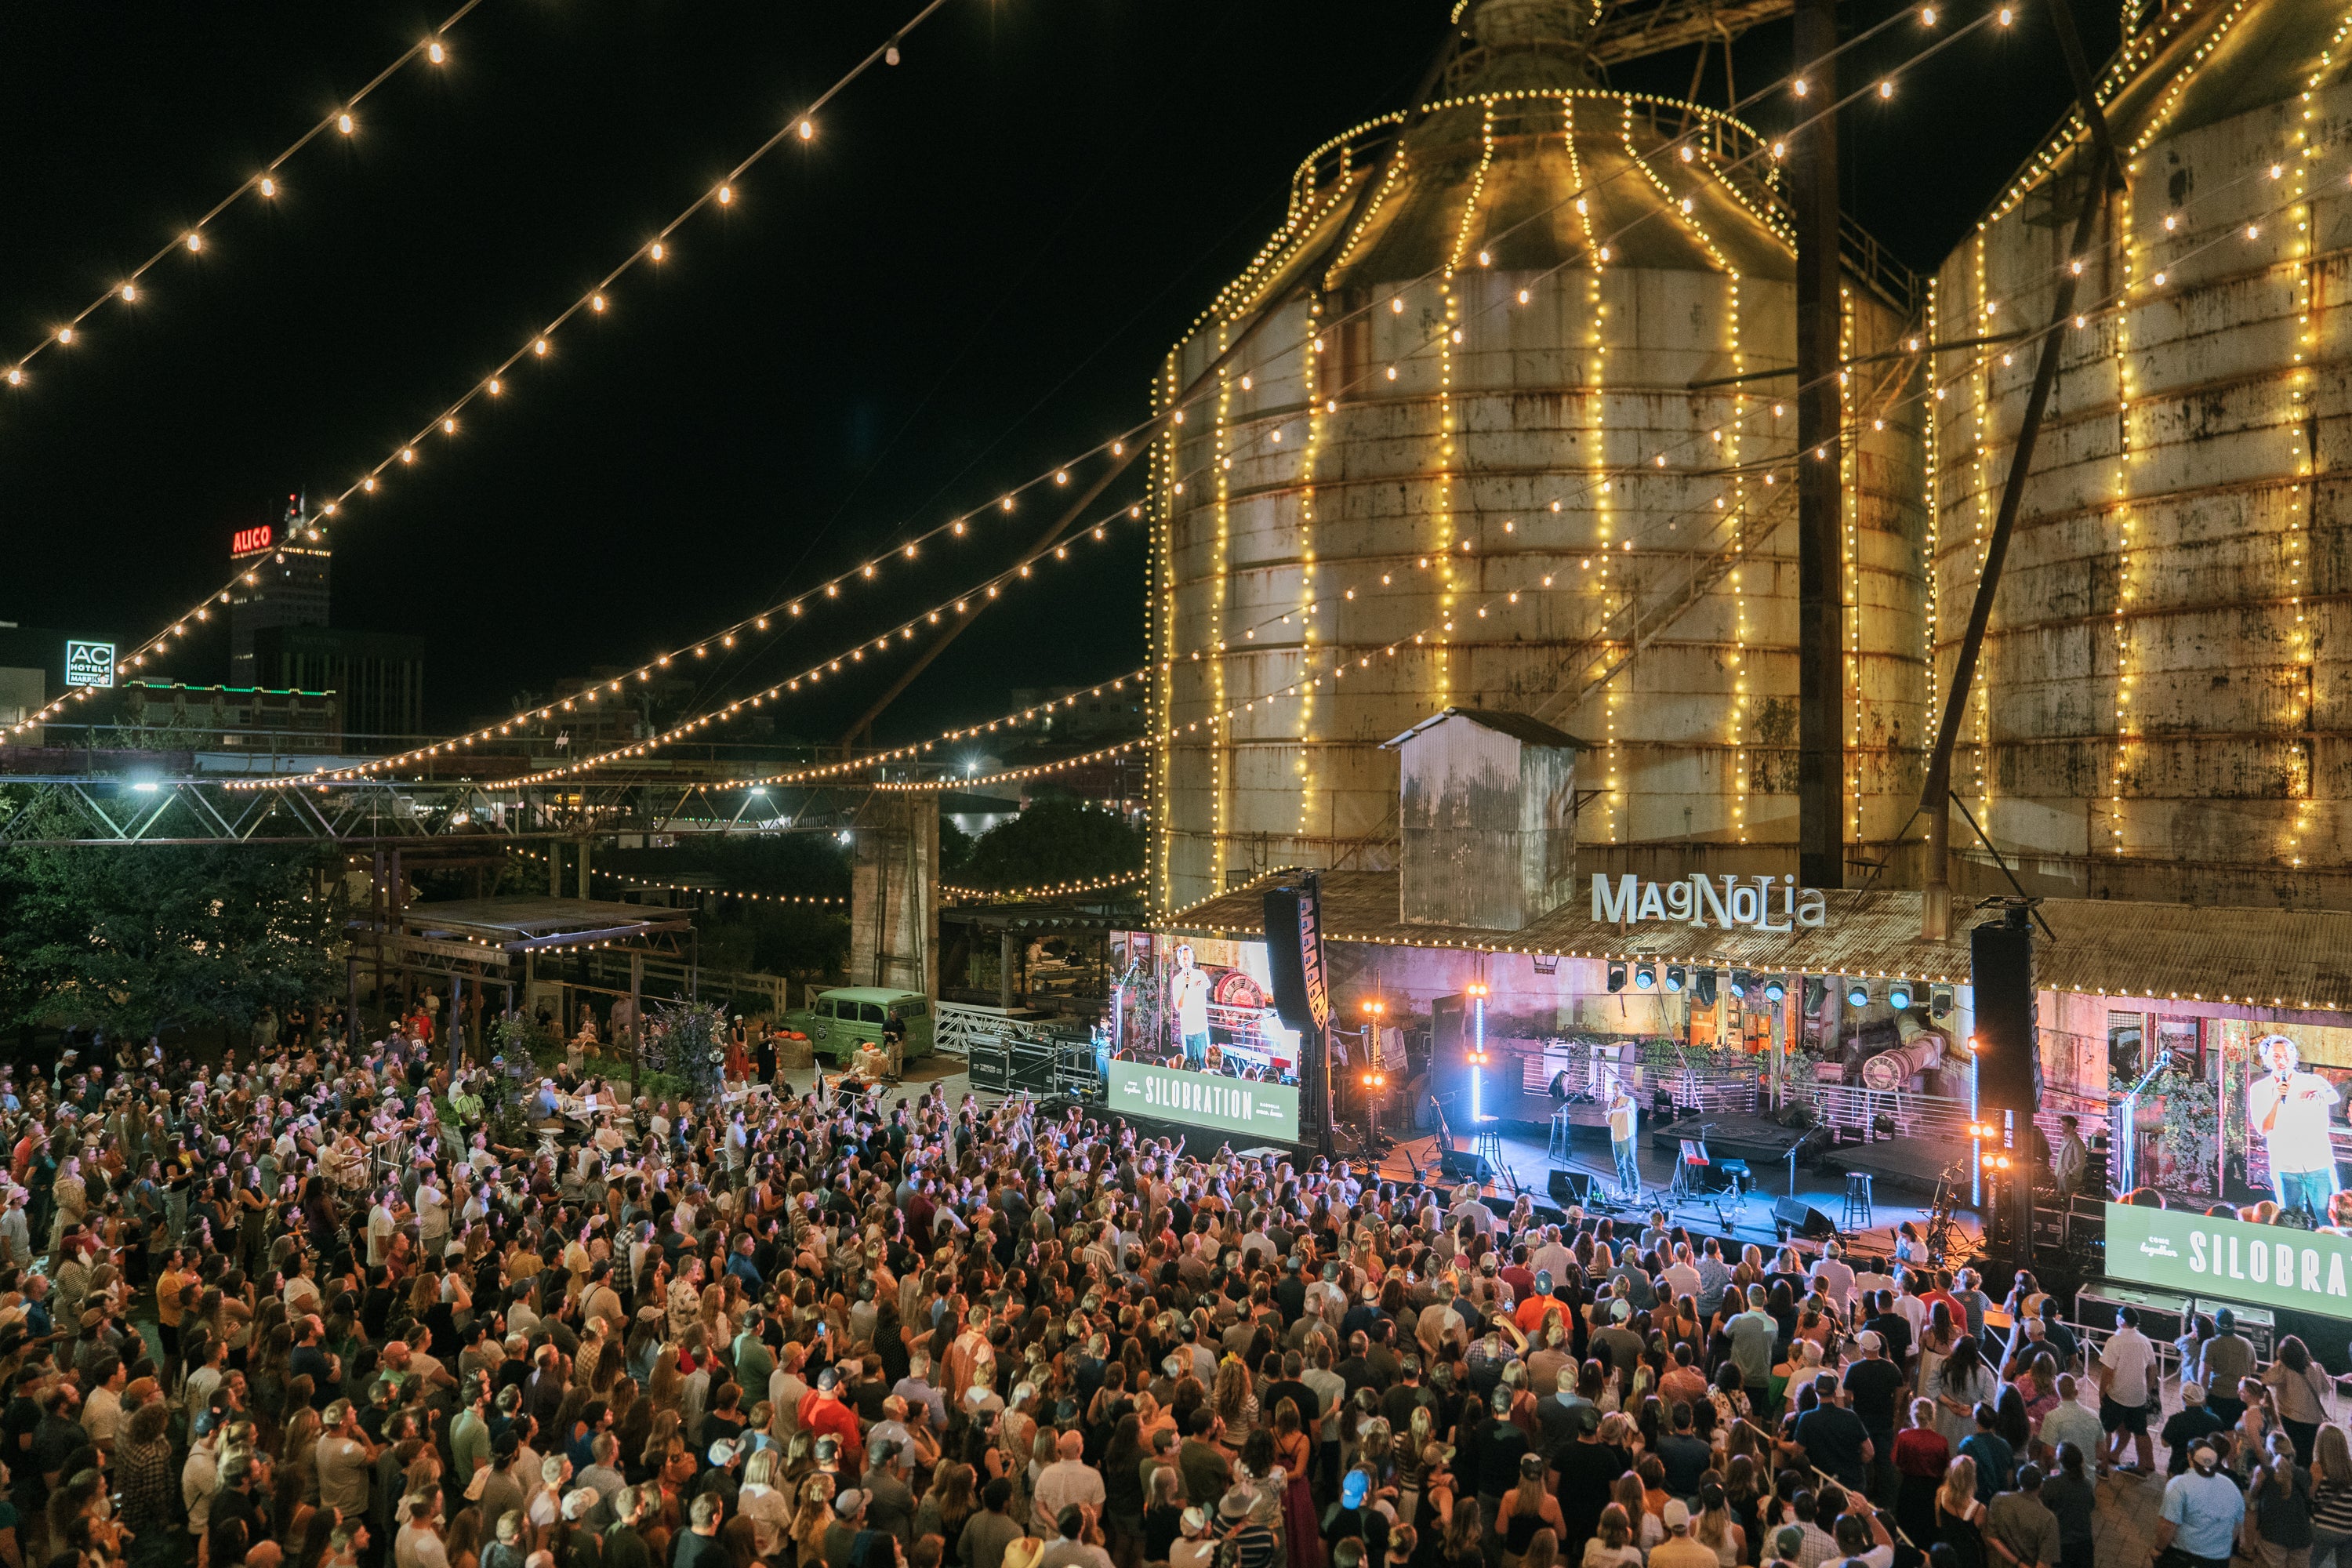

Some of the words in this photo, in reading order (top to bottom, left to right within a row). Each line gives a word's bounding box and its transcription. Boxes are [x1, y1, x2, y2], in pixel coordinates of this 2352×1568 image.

[234, 525, 271, 553] ALICO
[71, 645, 111, 665] AC
[71, 663, 110, 673] HOTELS
[1145, 1076, 1252, 1120] SILOBRATION
[2189, 1231, 2352, 1298] SILOBRA
